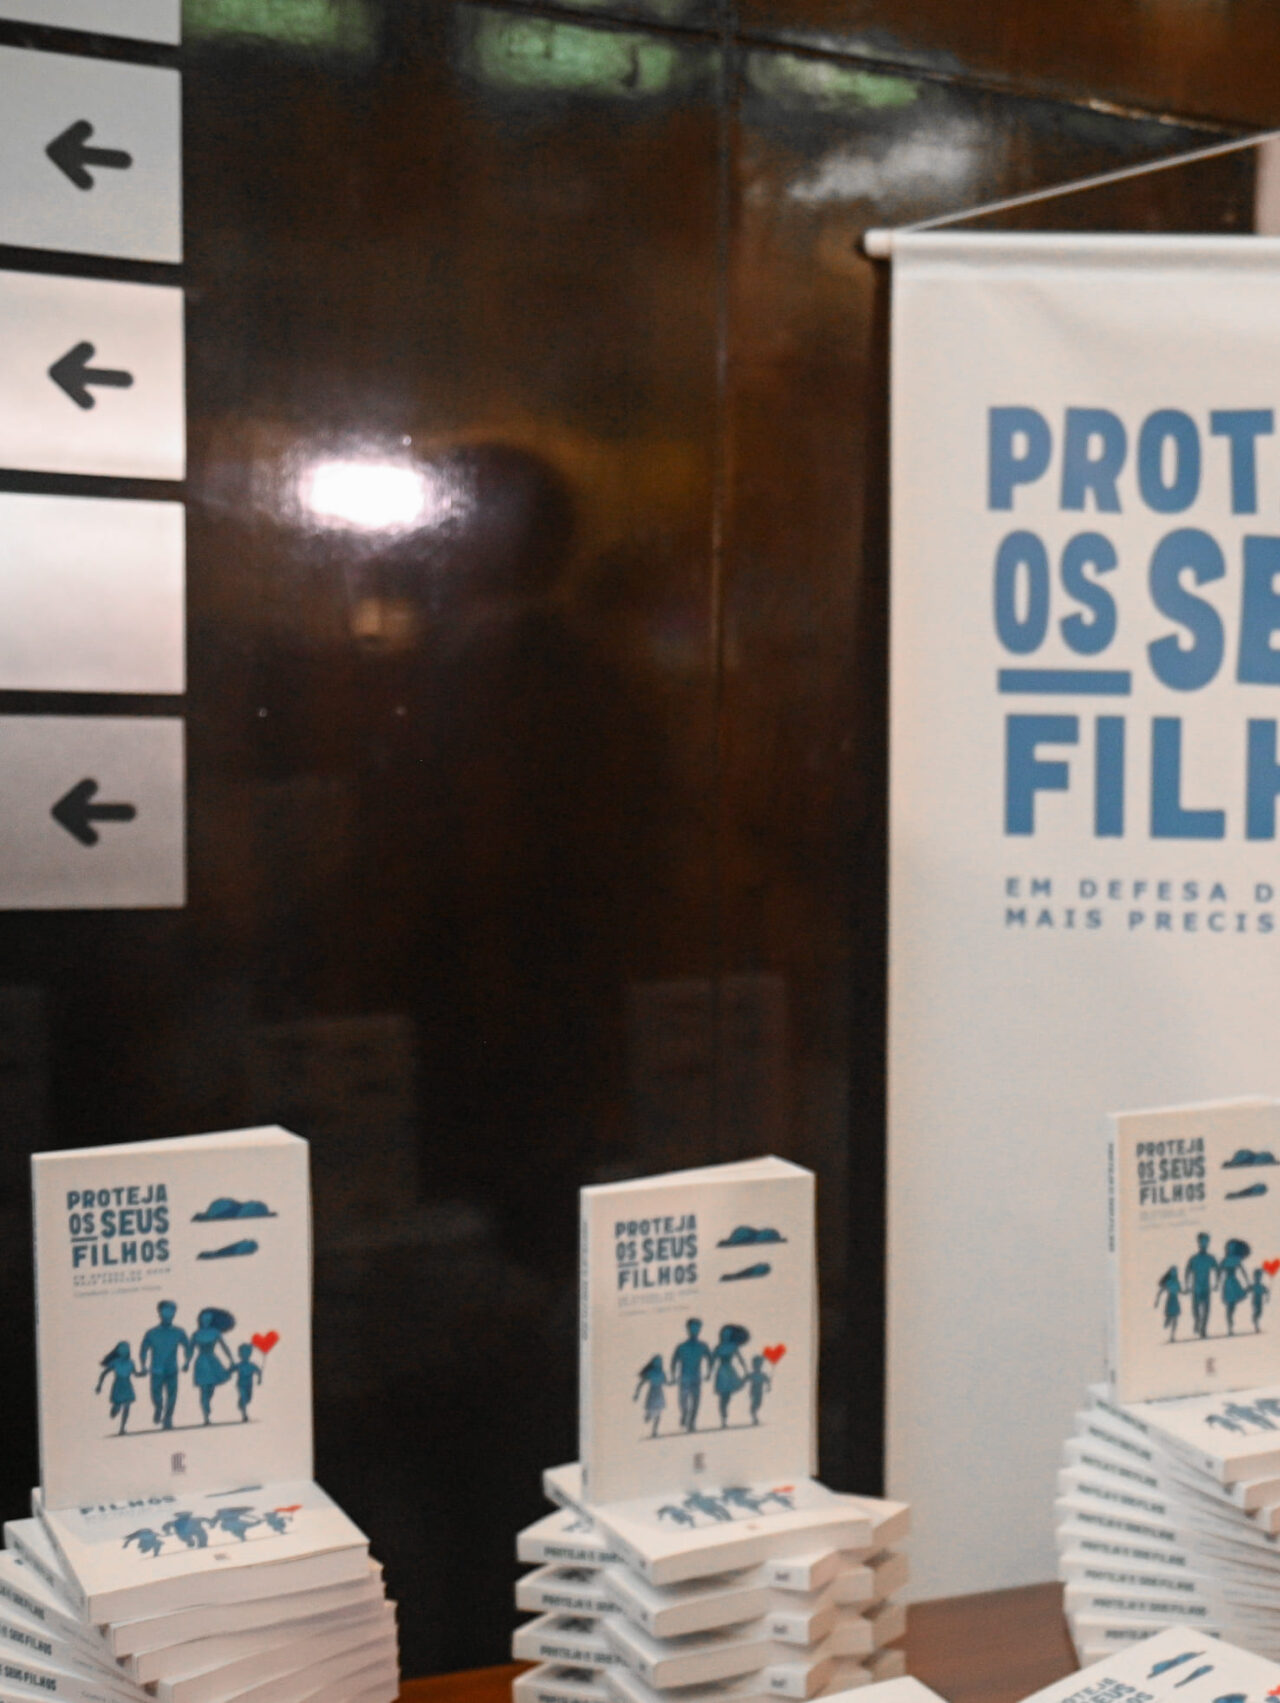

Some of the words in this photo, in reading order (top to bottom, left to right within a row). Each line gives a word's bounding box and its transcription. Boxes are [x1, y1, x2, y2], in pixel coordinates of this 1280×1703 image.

[993, 529, 1118, 656] OS
[1006, 877, 1052, 899] EM
[1080, 879, 1227, 903] DEFESA
[1006, 907, 1102, 930] MAIS
[1136, 1137, 1204, 1158] PROTEJA
[1138, 1160, 1154, 1180] OS
[1159, 1155, 1205, 1182] SEUS
[67, 1184, 168, 1211] PROTEJA
[1139, 1182, 1205, 1205] FILHOS
[69, 1212, 95, 1236] OS
[100, 1205, 169, 1239] SEUS
[615, 1215, 697, 1239] PROTEJA
[72, 1238, 169, 1269] FILHOS
[616, 1240, 636, 1261] OS
[642, 1233, 697, 1263] SEUS
[618, 1262, 697, 1291] FILHOS
